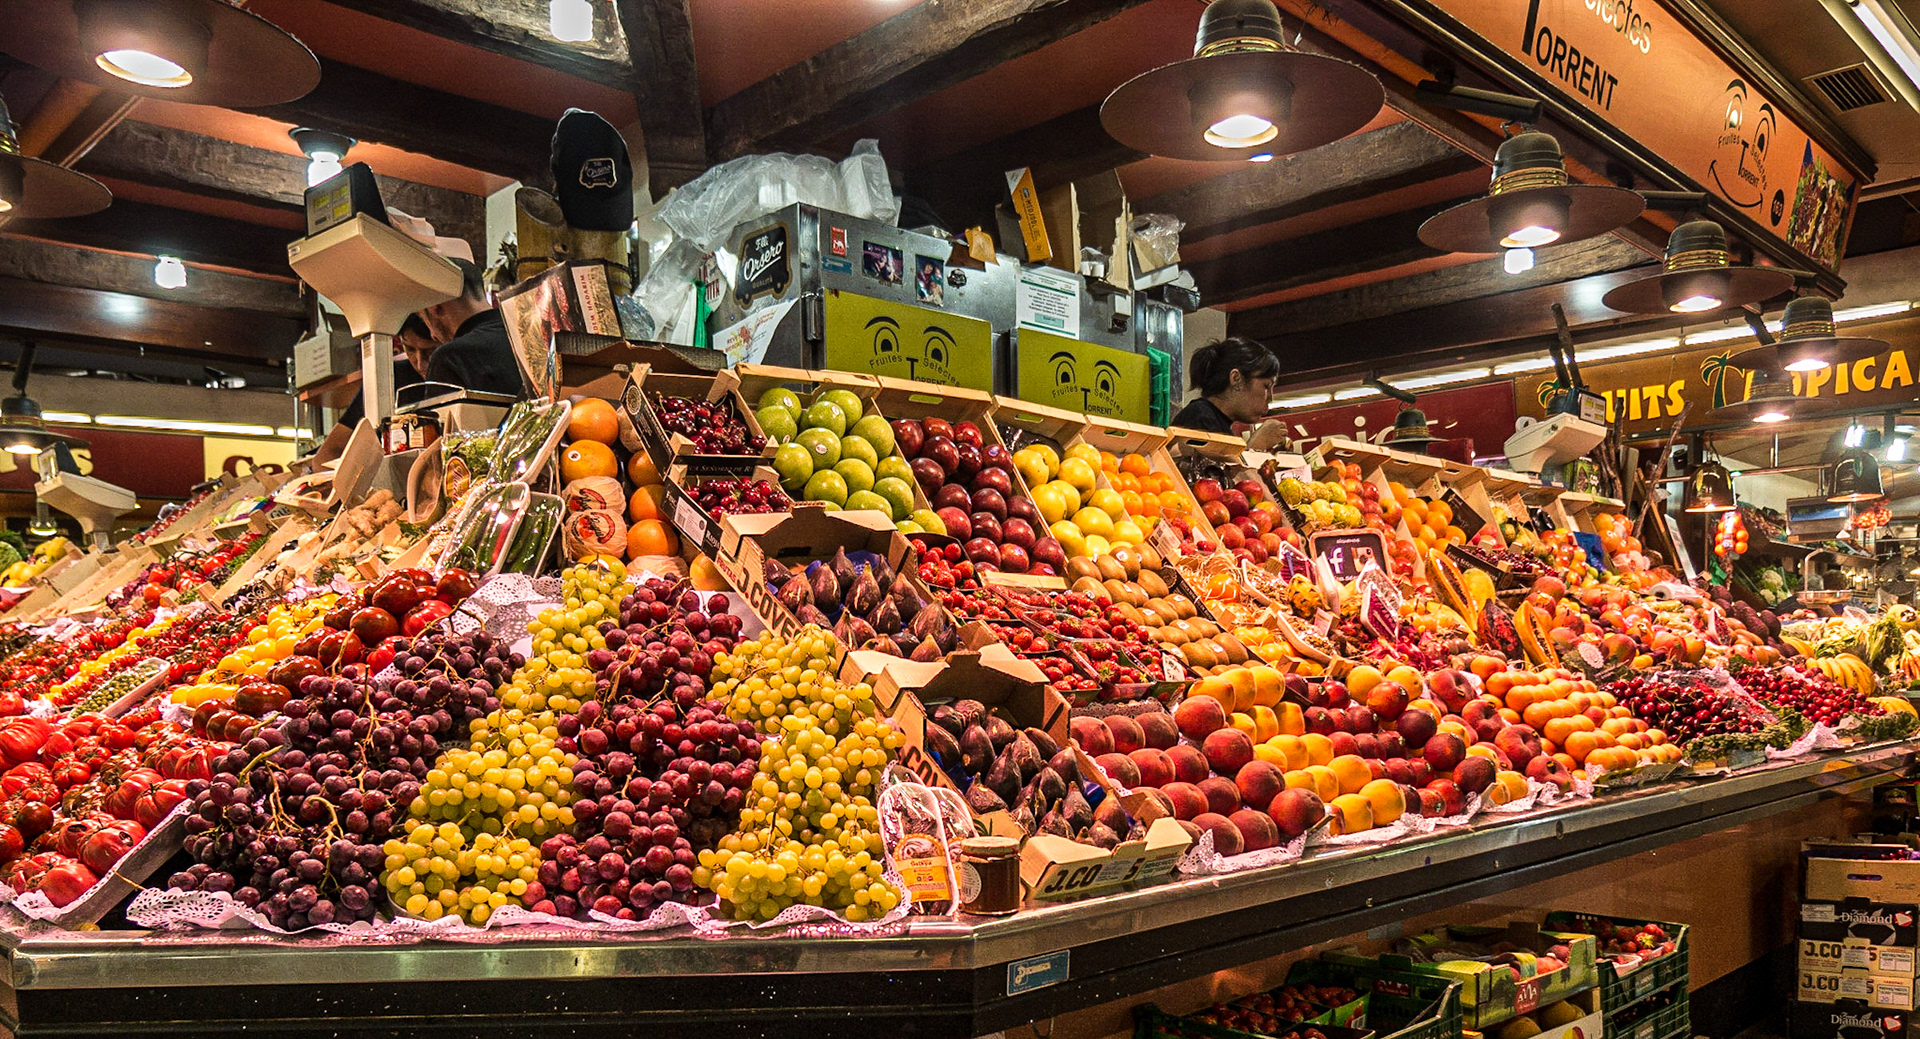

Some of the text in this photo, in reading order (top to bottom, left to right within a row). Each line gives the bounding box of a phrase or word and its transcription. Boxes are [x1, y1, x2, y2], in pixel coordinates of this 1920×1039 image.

[743, 241, 784, 281] Orsero
[869, 354, 903, 369] Fruites
[1052, 385, 1124, 415] Fruites Selectes
[1081, 387, 1112, 415] TORRENT
[1841, 911, 1893, 925] Diamond
[1830, 1014, 1882, 1029] Diamond
